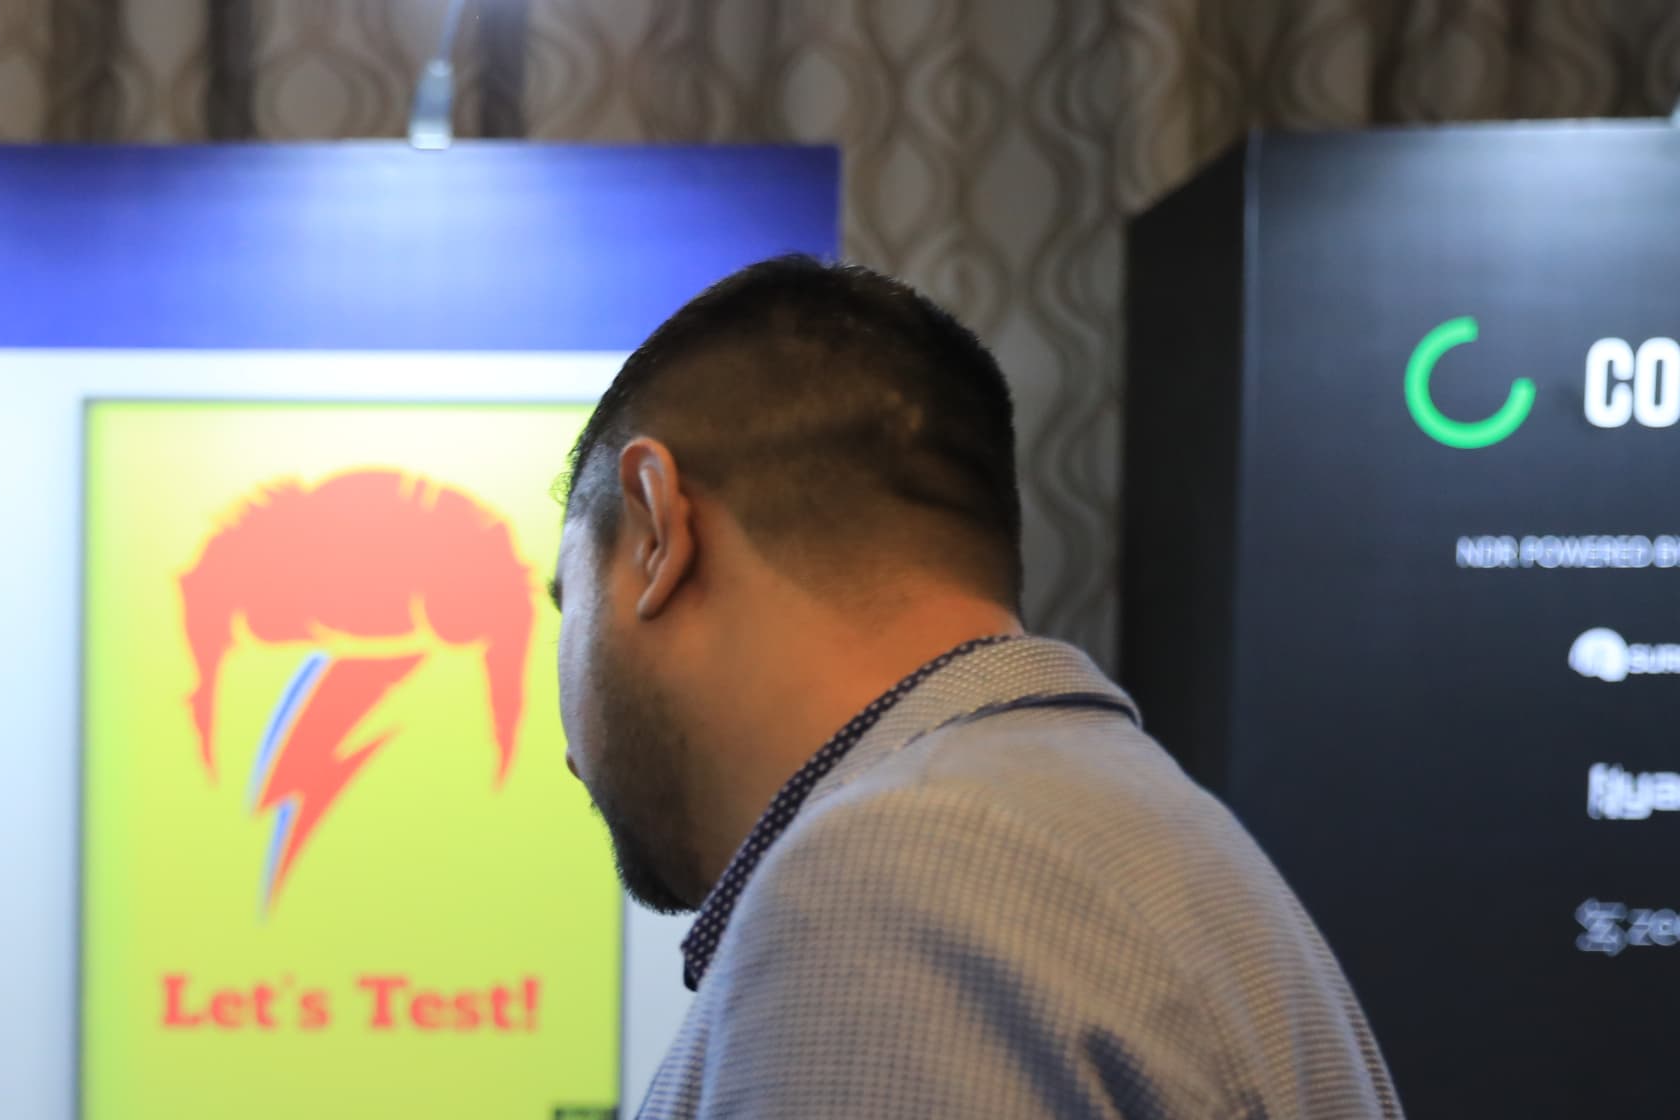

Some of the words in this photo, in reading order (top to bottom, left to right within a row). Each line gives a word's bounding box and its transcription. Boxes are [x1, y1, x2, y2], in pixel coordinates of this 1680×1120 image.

[1519, 534, 1653, 568] POWERED
[162, 973, 332, 1031] Let's
[355, 975, 543, 1033] Test!
